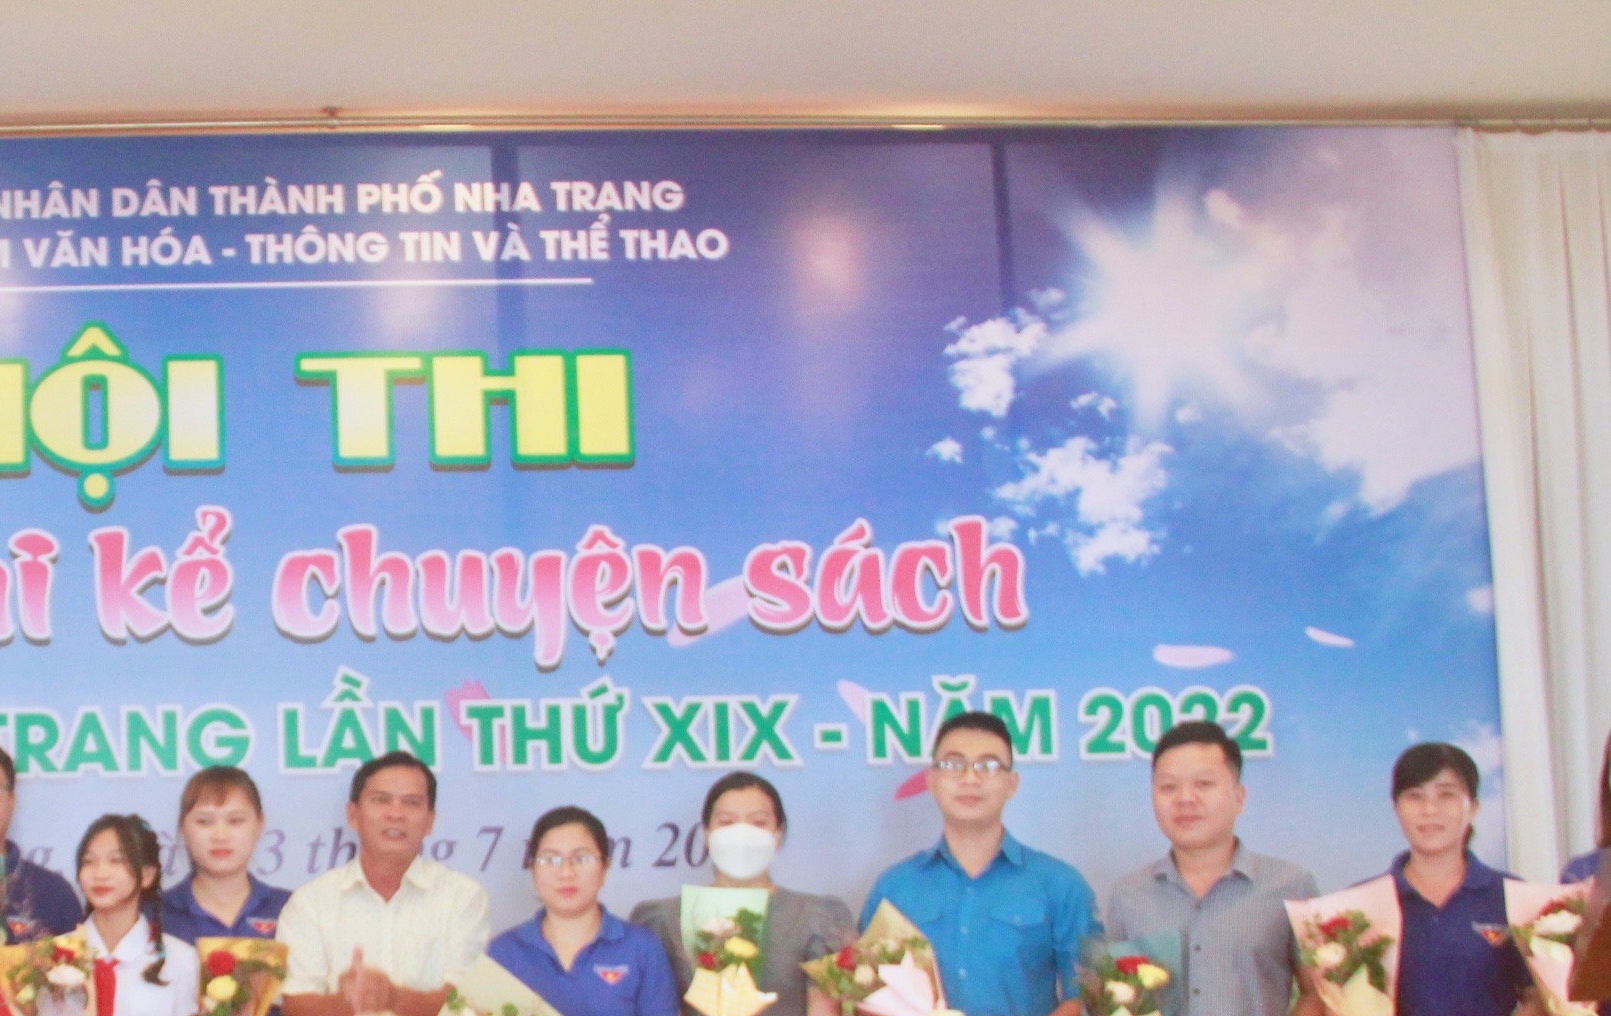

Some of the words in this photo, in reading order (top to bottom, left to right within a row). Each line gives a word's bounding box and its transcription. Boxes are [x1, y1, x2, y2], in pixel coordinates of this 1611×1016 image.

[111, 179, 198, 218] DÂN
[209, 176, 345, 216] THÀNH
[357, 170, 444, 214] PHỐ
[454, 182, 541, 213] NHA
[550, 180, 685, 212] TRANG
[23, 230, 108, 269] VĂN
[121, 227, 212, 267] HÓA
[245, 224, 389, 264] THÔNG
[399, 231, 462, 262] TIN
[472, 222, 532, 261] VÀ
[539, 213, 611, 260] THỂ
[619, 229, 730, 259] THAO
[295, 350, 635, 472] THI
[89, 505, 234, 644] kể
[271, 522, 708, 672] chuyện
[741, 514, 1030, 630] sách
[283, 674, 435, 770] LẦN
[462, 680, 626, 767] THỨ
[654, 697, 794, 762] XIX
[819, 729, 843, 745] -
[478, 825, 504, 872] 7
